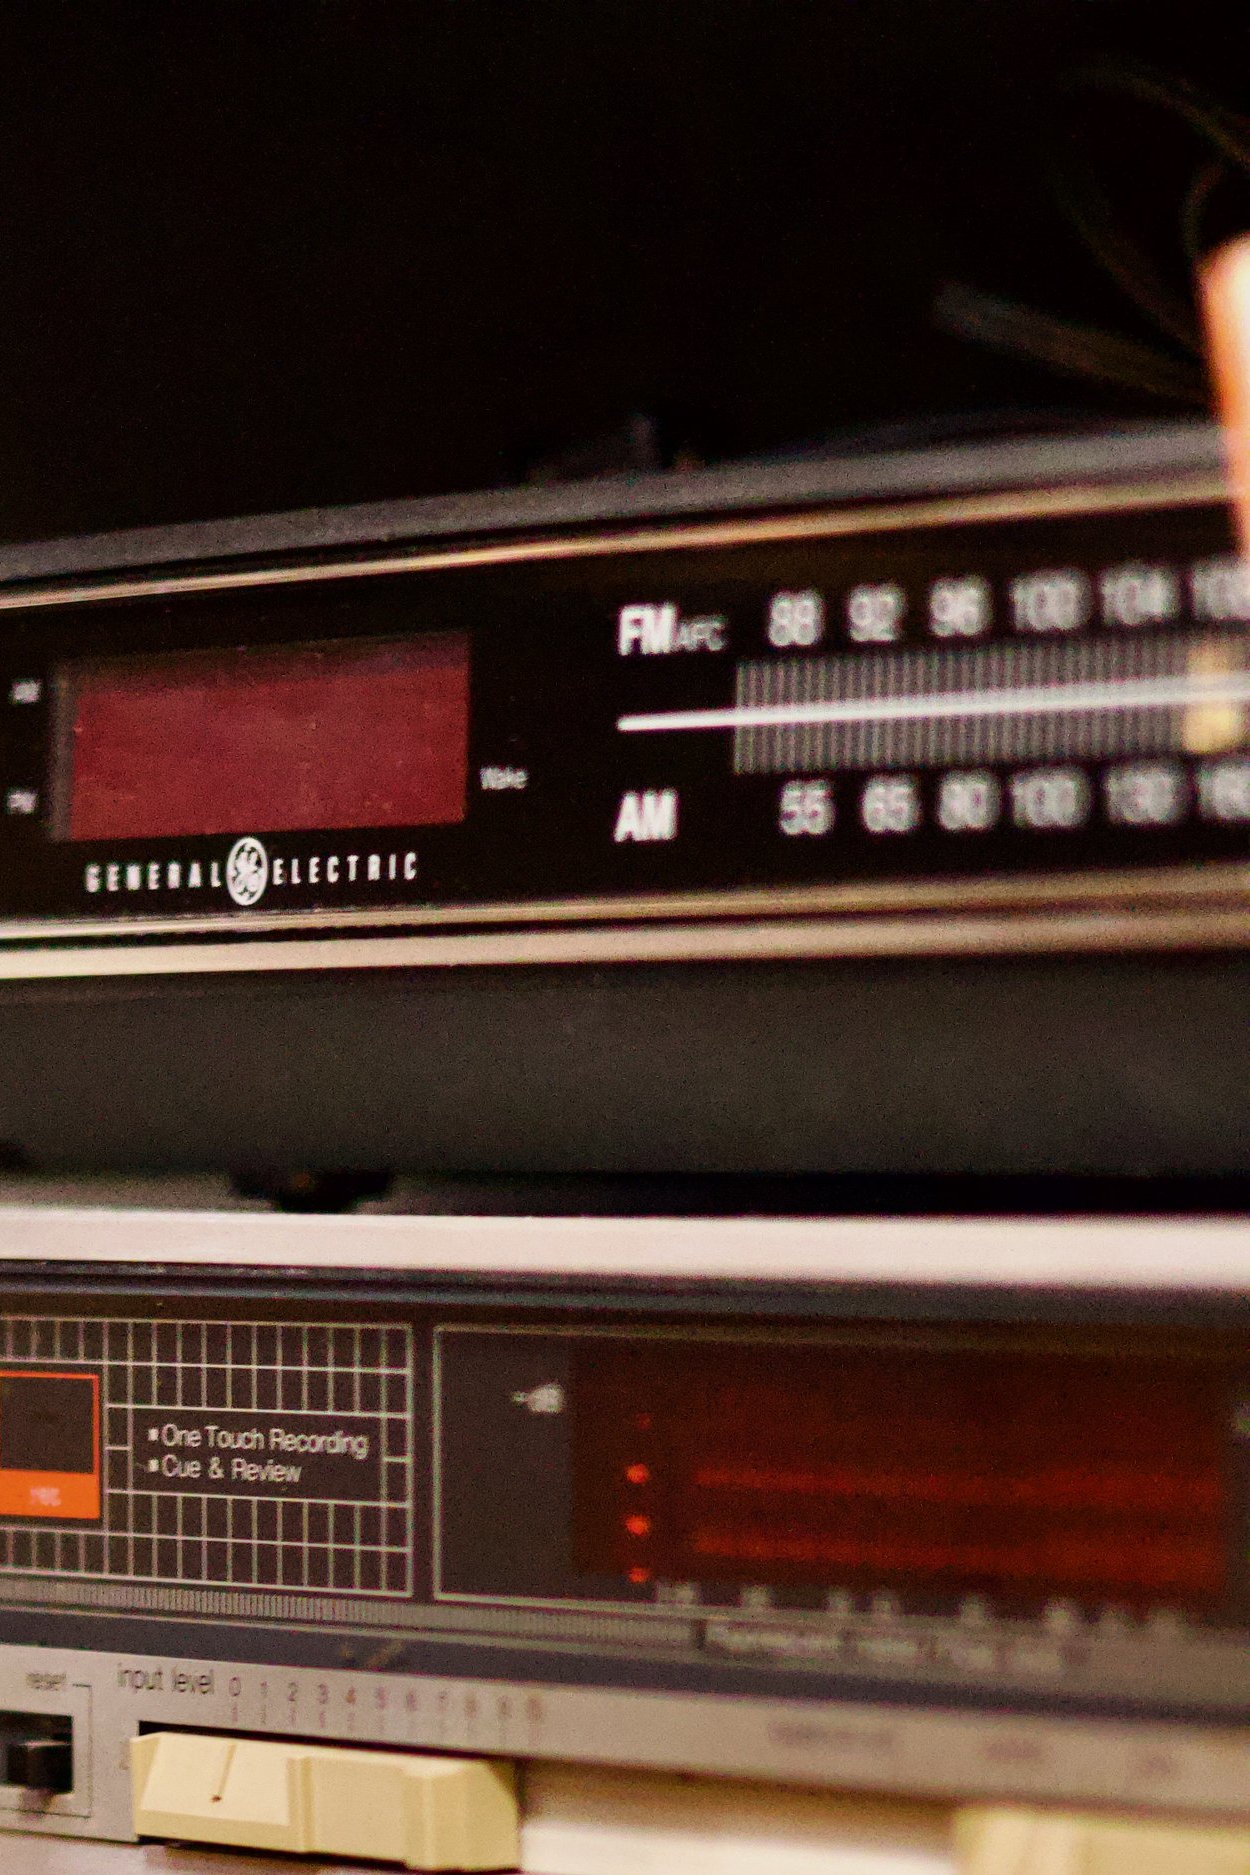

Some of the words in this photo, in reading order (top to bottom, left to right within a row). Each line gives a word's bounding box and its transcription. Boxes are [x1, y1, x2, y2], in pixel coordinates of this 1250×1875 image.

[620, 602, 676, 656] FM
[767, 591, 822, 647] 88
[613, 788, 679, 842] AM
[780, 779, 834, 835] 55
[862, 775, 919, 832] 65
[84, 860, 222, 893] GENERAL
[272, 851, 418, 886] ELECTRIC
[161, 1423, 201, 1447] One
[204, 1424, 265, 1450] Touch
[269, 1427, 369, 1460] Recording
[161, 1454, 201, 1478] Cue
[208, 1456, 224, 1479] &
[231, 1457, 302, 1483] Review
[117, 1662, 163, 1693] input
[171, 1665, 215, 1694] level
[228, 1676, 242, 1697] 0
[287, 1681, 299, 1702] 2
